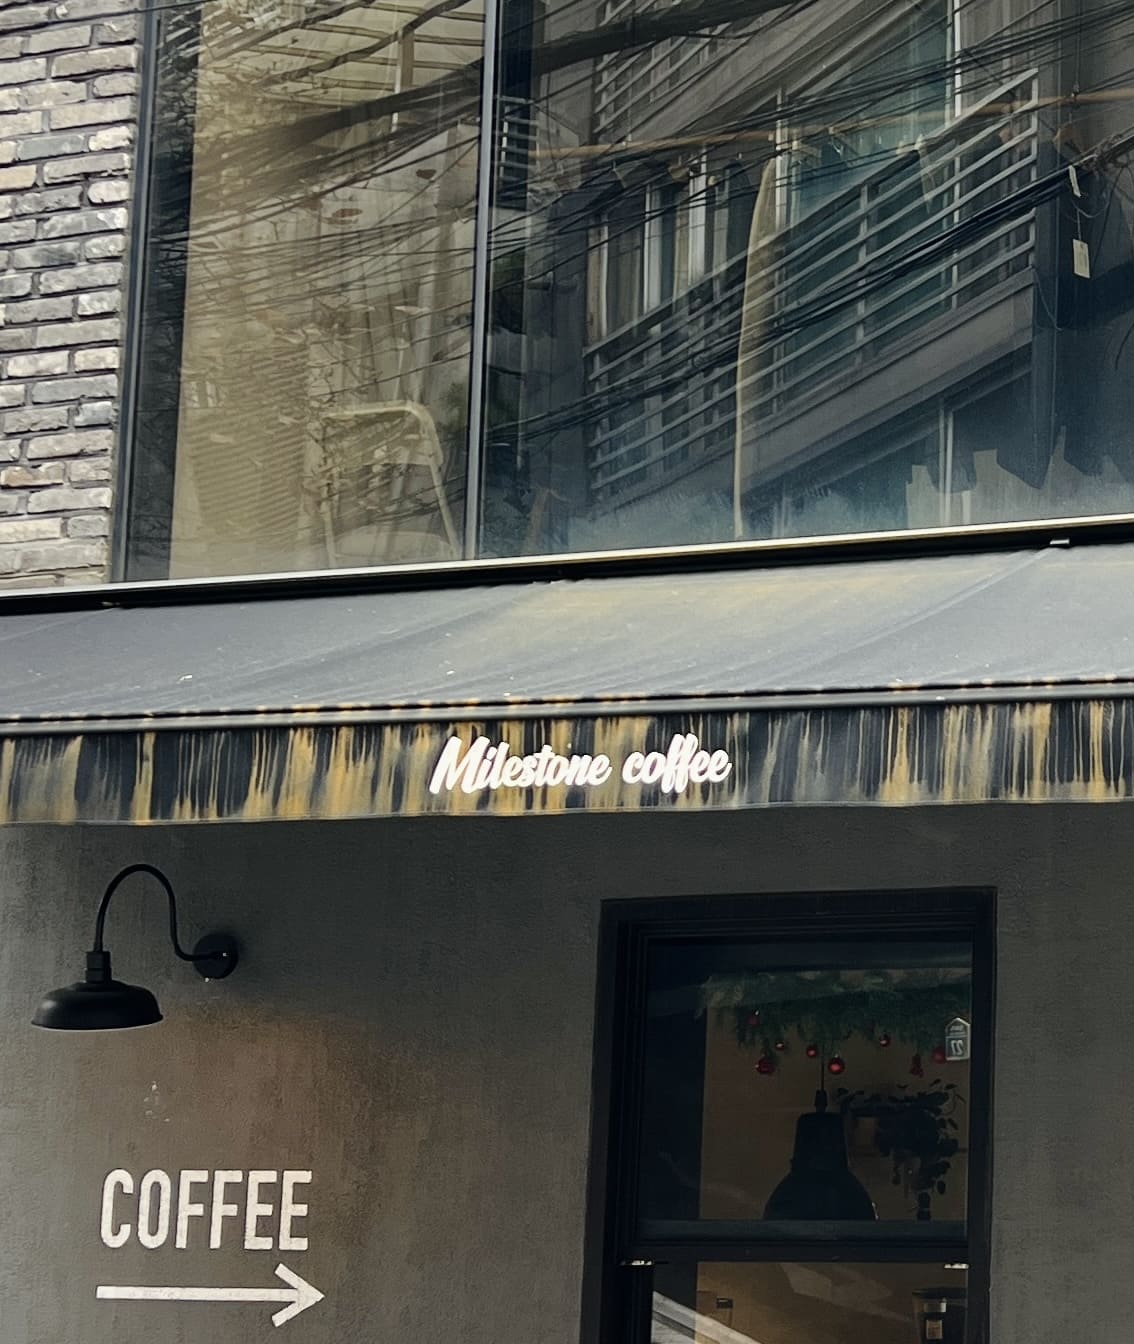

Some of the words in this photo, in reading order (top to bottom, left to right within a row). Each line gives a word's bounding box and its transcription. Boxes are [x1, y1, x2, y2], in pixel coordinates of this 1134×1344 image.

[429, 736, 613, 794] Milestone
[622, 733, 733, 793] coffee
[100, 1168, 313, 1251] COFFEE
